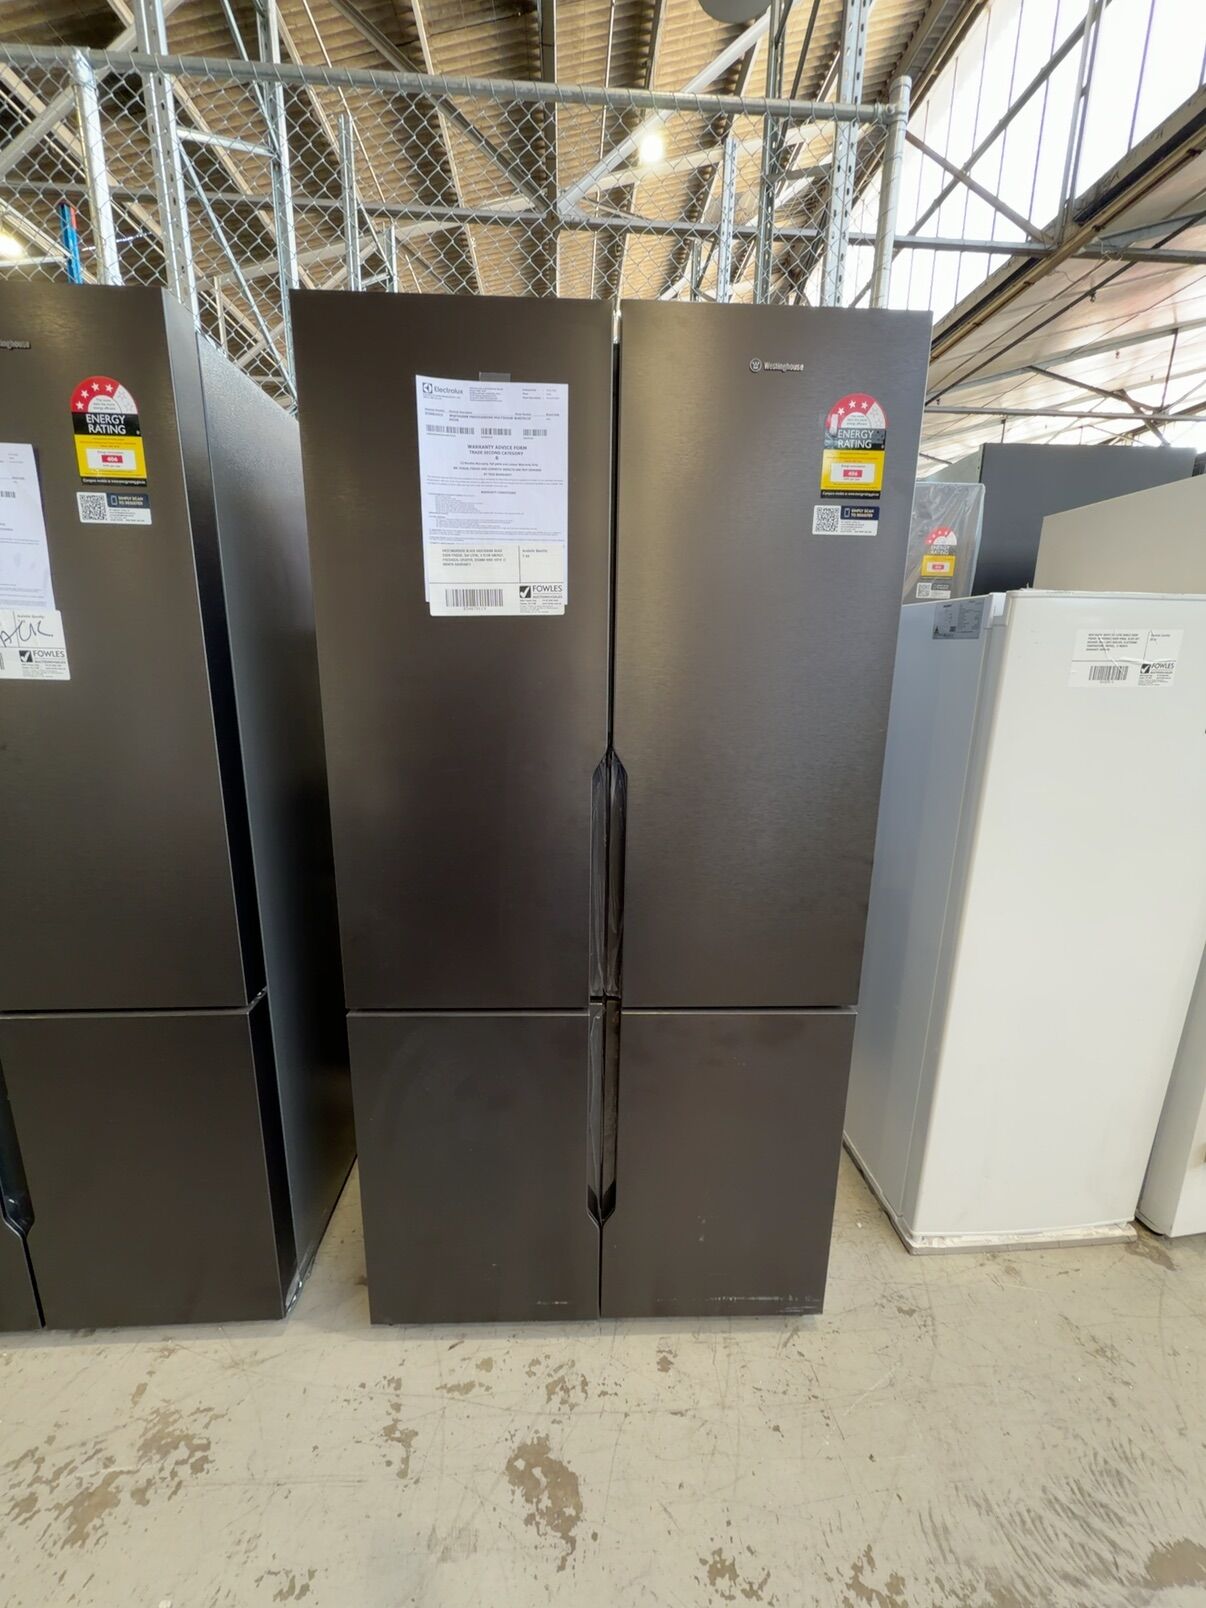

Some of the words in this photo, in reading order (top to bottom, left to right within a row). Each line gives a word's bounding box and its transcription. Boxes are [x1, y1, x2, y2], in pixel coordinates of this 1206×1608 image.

[764, 361, 804, 372] Westinghouse
[434, 385, 463, 394] Electrolux
[86, 414, 126, 425] ENERGY
[88, 424, 126, 435] RATING
[837, 429, 874, 439] ENERGY
[837, 439, 872, 449] RATING
[532, 585, 563, 593] FOWLES
[33, 650, 65, 658] FOWLES
[1151, 662, 1175, 670] FOWLES
